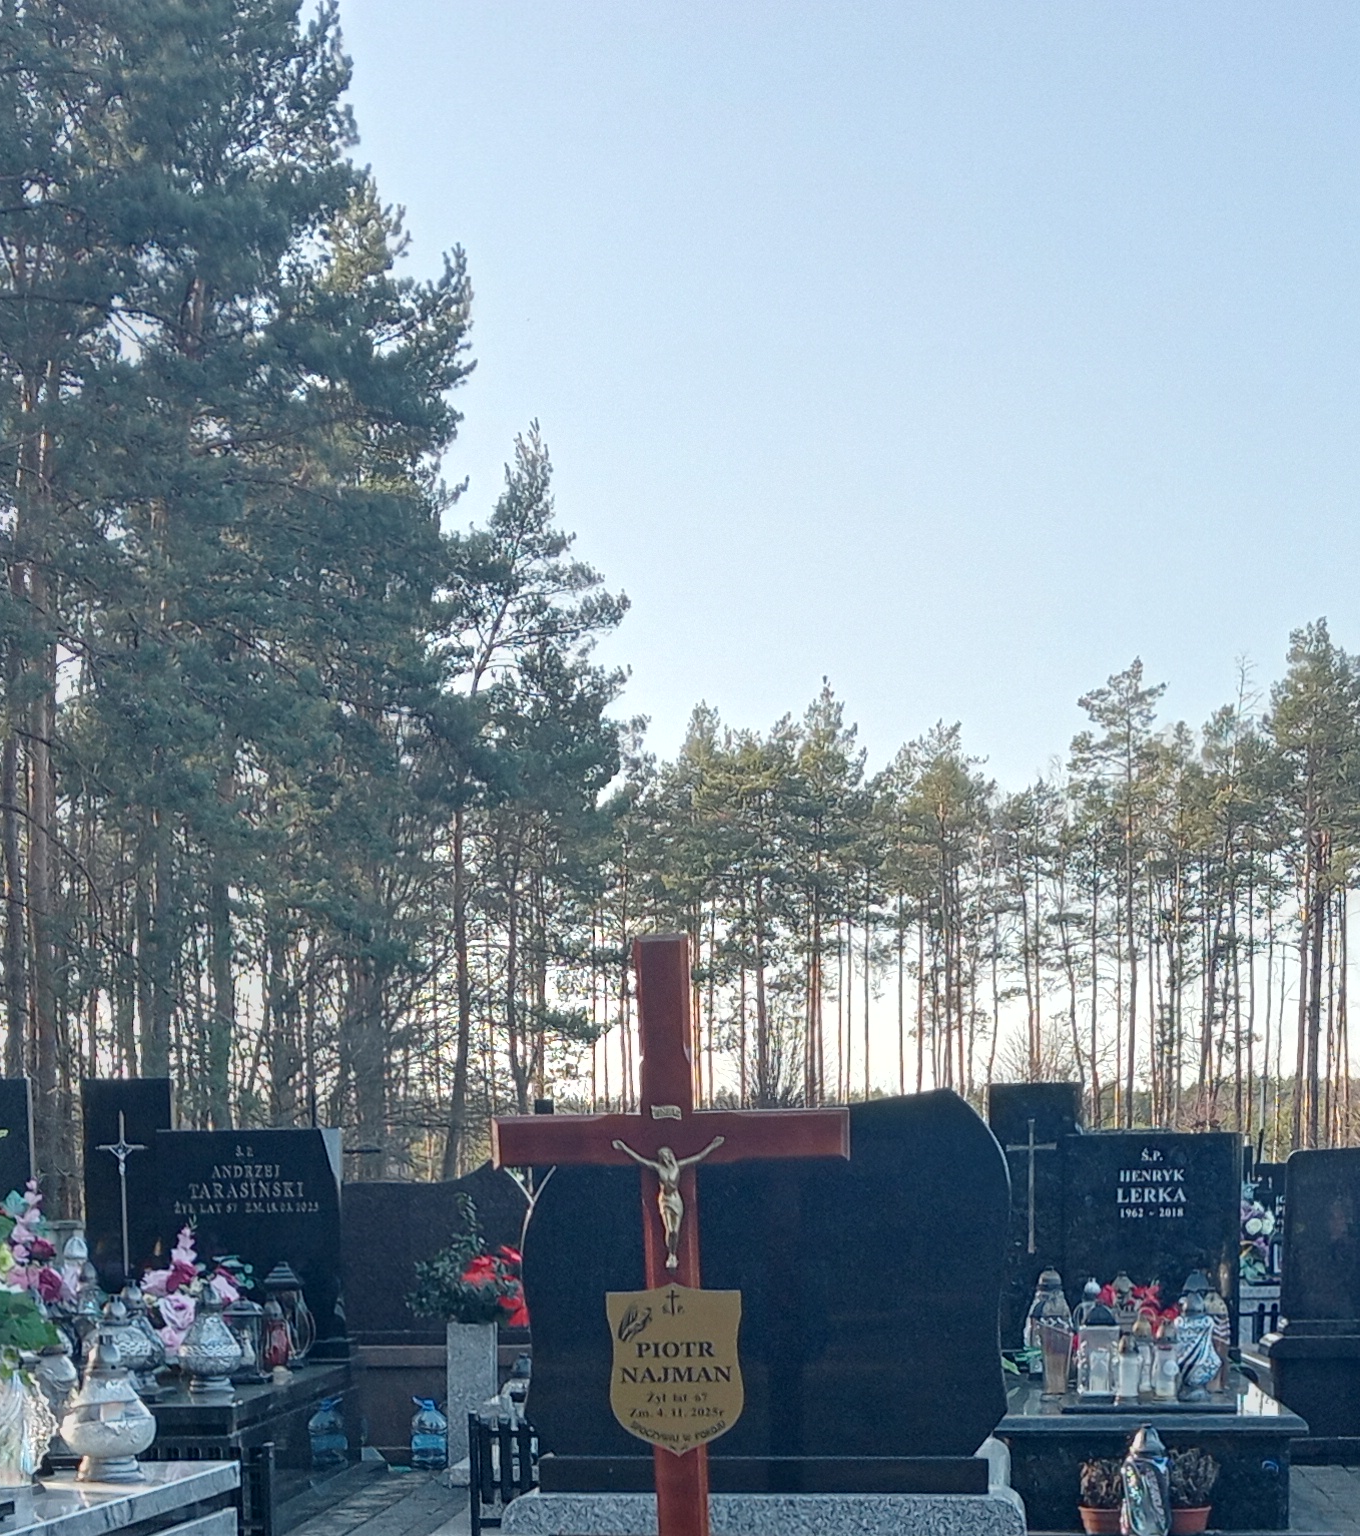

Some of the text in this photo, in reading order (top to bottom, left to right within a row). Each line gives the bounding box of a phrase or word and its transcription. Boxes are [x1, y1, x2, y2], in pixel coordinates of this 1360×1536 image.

[1141, 1148, 1164, 1161] Ś.P.
[212, 1164, 281, 1179] ANDRZEJ
[1119, 1169, 1185, 1182] HENRYK
[1116, 1187, 1187, 1203] LERKA
[200, 1202, 223, 1214] LAT
[1159, 1207, 1184, 1218] 2018
[636, 1341, 716, 1358] PIOTR
[620, 1366, 732, 1384] NAJMAN
